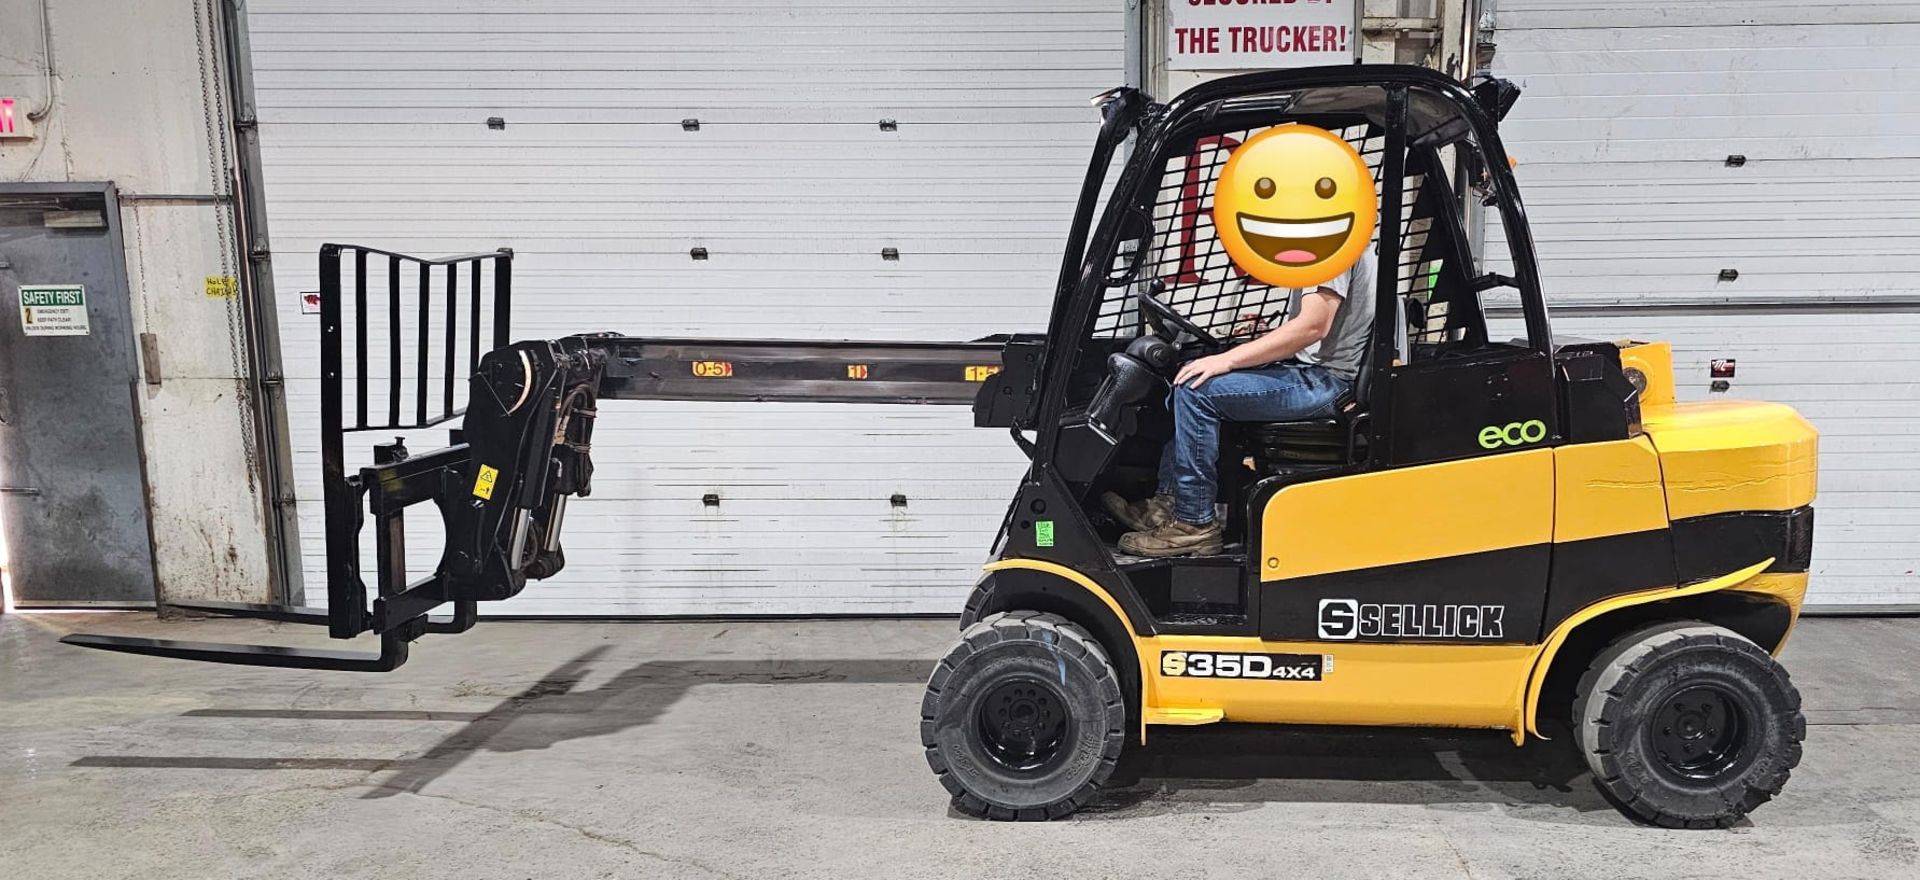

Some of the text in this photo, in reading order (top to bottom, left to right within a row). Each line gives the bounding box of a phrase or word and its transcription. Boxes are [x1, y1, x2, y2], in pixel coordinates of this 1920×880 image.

[1175, 25, 1346, 54] THE TRUCKER!
[23, 290, 81, 305] SAFETY FIRST
[1478, 419, 1547, 449] eco
[1359, 603, 1505, 638] SELLICK
